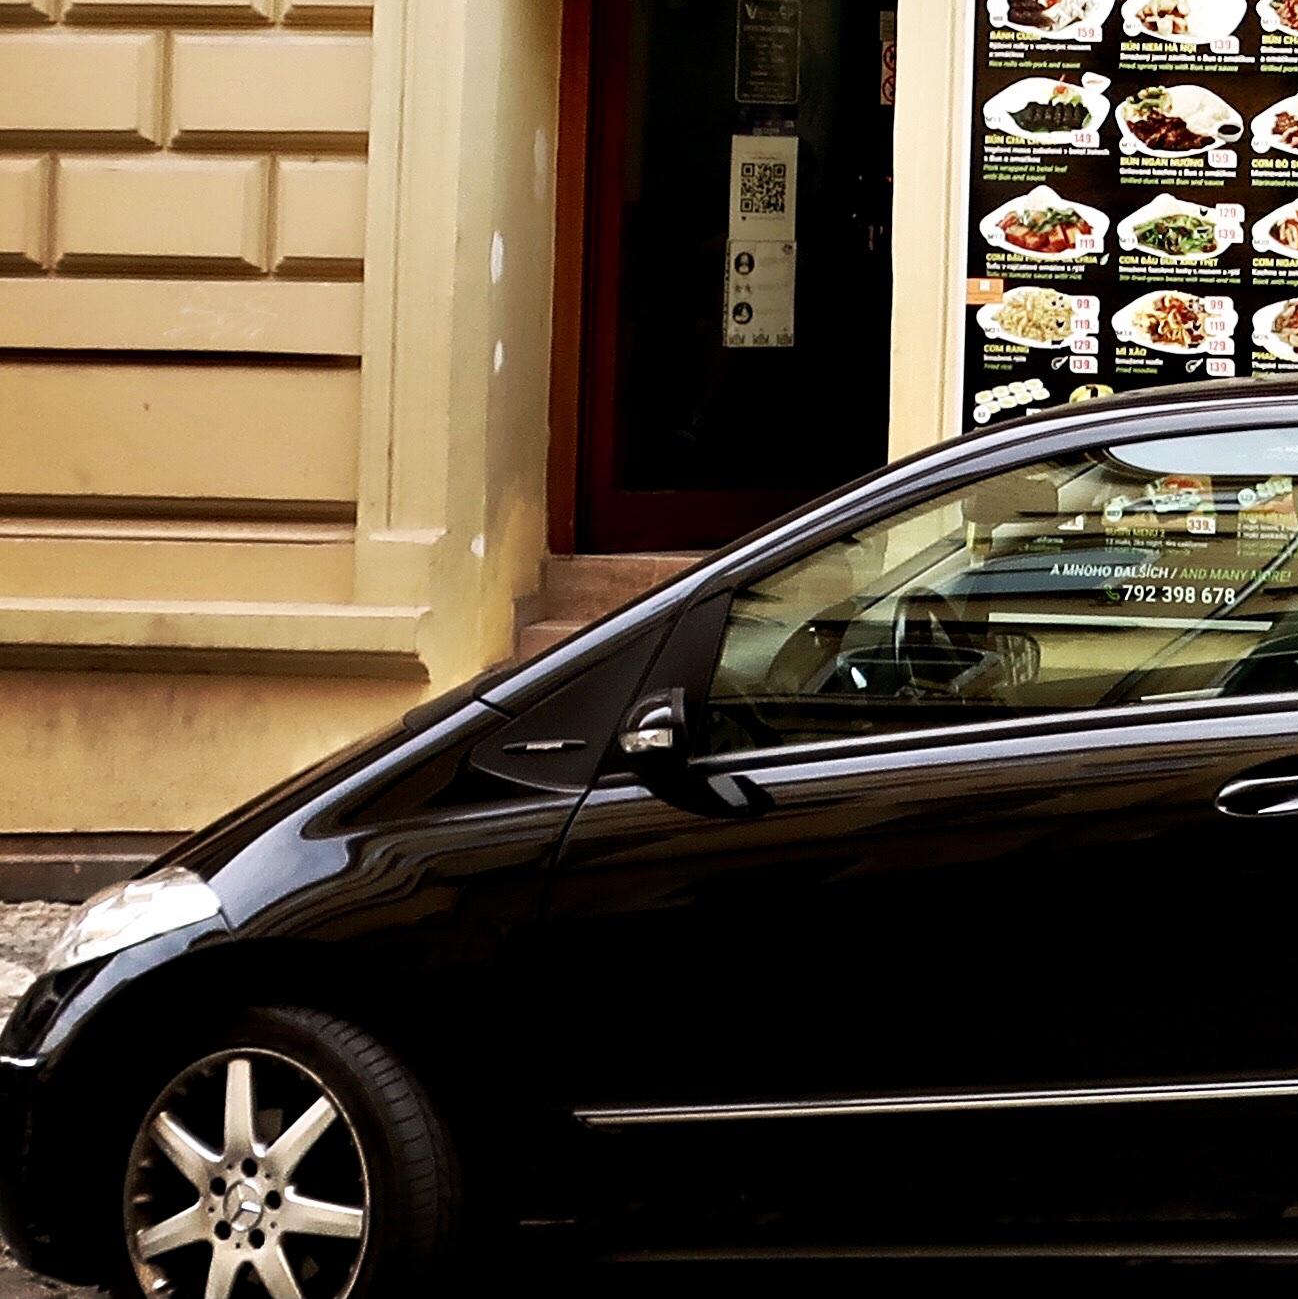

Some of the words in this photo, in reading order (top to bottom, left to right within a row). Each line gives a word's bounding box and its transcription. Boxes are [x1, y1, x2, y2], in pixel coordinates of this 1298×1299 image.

[1051, 564, 1060, 575] A
[1062, 565, 1111, 578] MNOHO
[1114, 564, 1169, 579] DALŠÍCH
[1180, 568, 1207, 580] AND
[1209, 569, 1248, 581] MANY
[1122, 585, 1156, 602] 792
[1162, 585, 1196, 603] 398
[1201, 587, 1236, 605] 678
